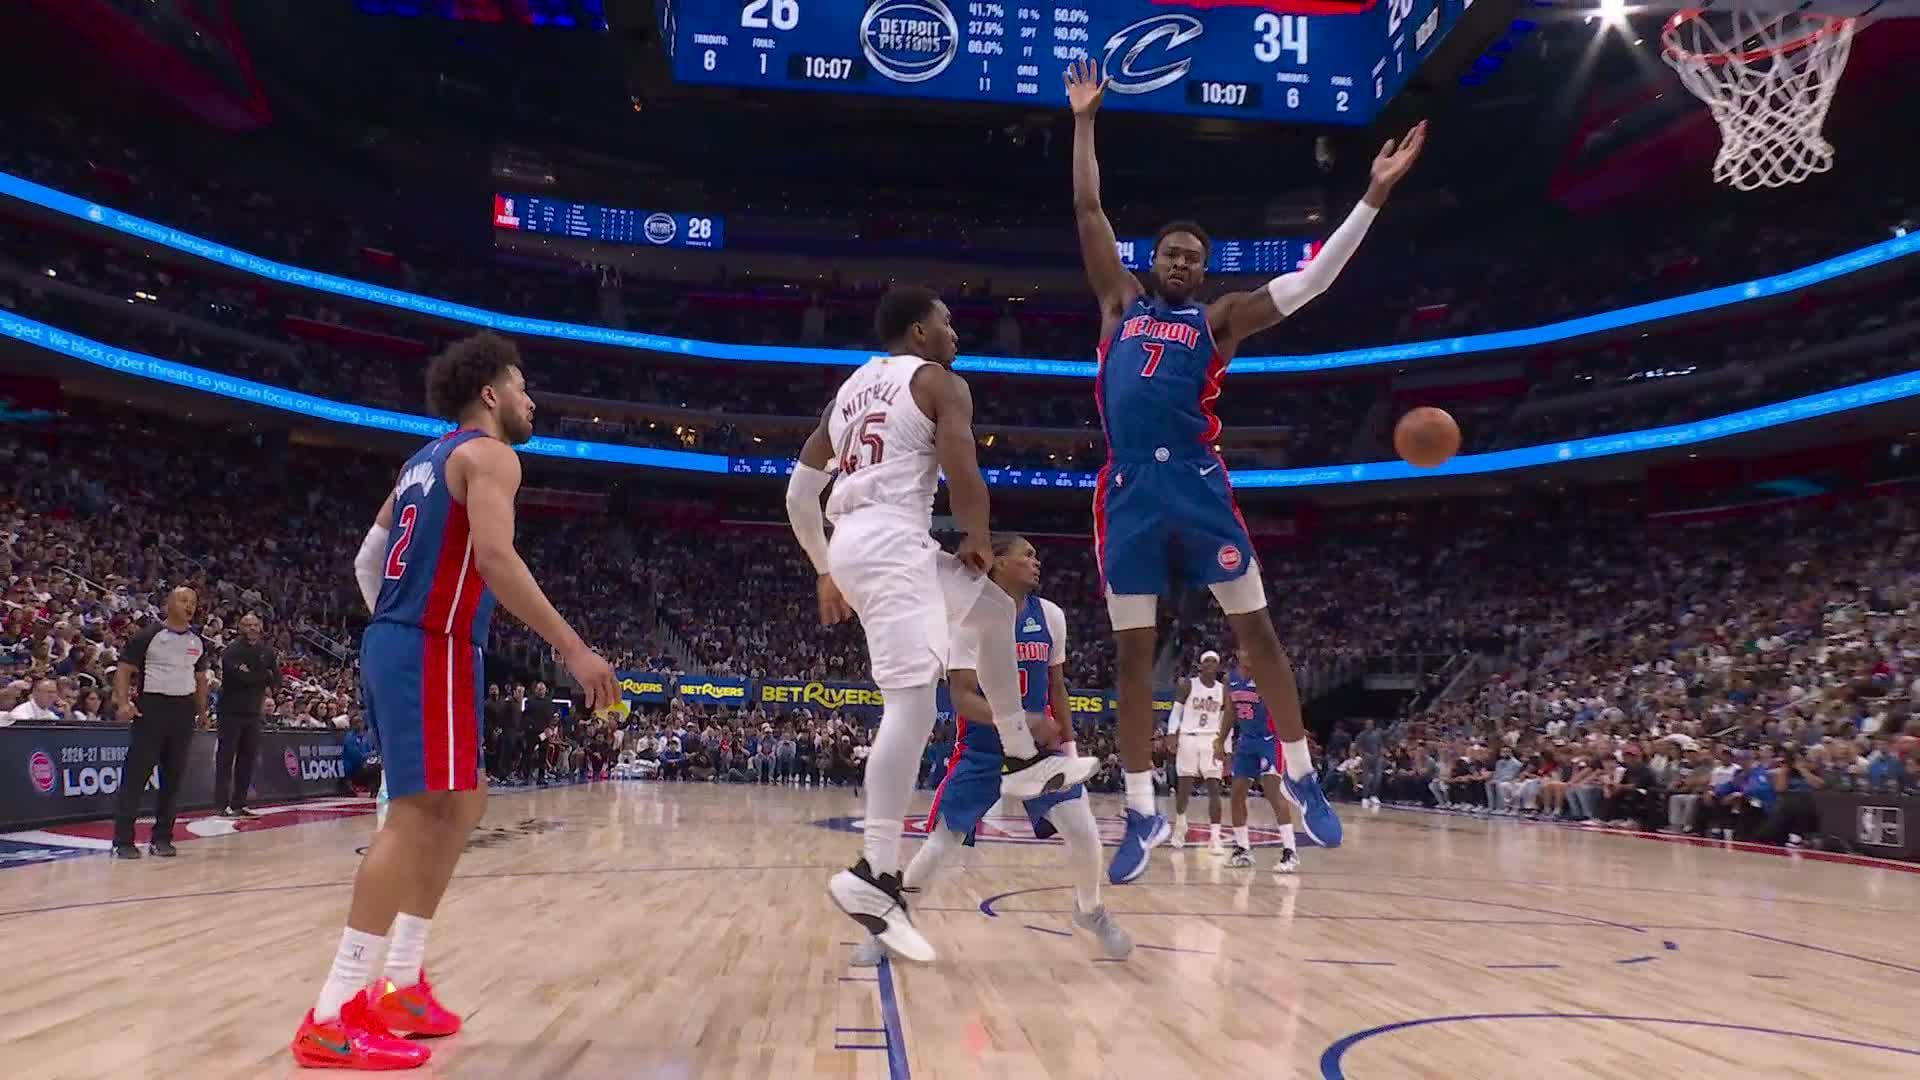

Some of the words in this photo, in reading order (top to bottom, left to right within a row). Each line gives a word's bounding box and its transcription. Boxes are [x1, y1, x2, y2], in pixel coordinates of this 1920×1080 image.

[741, 0, 799, 31] 26
[969, 3, 1004, 18] 41.7%
[1054, 8, 1088, 24] 50.0%
[879, 18, 941, 36] DETROIT
[1054, 27, 1088, 42] 40.0%
[879, 33, 941, 52] PISTONS
[1254, 13, 1308, 64] 34
[760, 53, 767, 75] 1
[805, 56, 852, 80] 10:07
[979, 78, 991, 91] 11
[1201, 82, 1248, 105] 10:07
[1287, 88, 1299, 108] 6
[1336, 91, 1349, 111] 2
[249, 256, 278, 275] block
[280, 268, 312, 284] cyber
[368, 289, 387, 301] you
[389, 294, 408, 304] can
[1120, 315, 1200, 350] DETROIT
[1141, 342, 1165, 378] 7
[49, 333, 68, 348] We
[72, 341, 106, 360] block
[106, 352, 144, 370] cyber
[149, 361, 193, 382] threats
[197, 376, 212, 386] so
[214, 378, 236, 394] you
[240, 386, 260, 398] can
[263, 388, 293, 407] focus
[296, 399, 311, 409] on
[366, 413, 398, 426] Learn
[400, 420, 431, 432] more
[384, 504, 417, 580] 2
[1016, 642, 1050, 662] ROIT
[619, 678, 663, 694] TRIVERS
[761, 682, 884, 709] BETRIVERS
[1193, 697, 1219, 713] CAVS
[301, 760, 338, 780] LOCK
